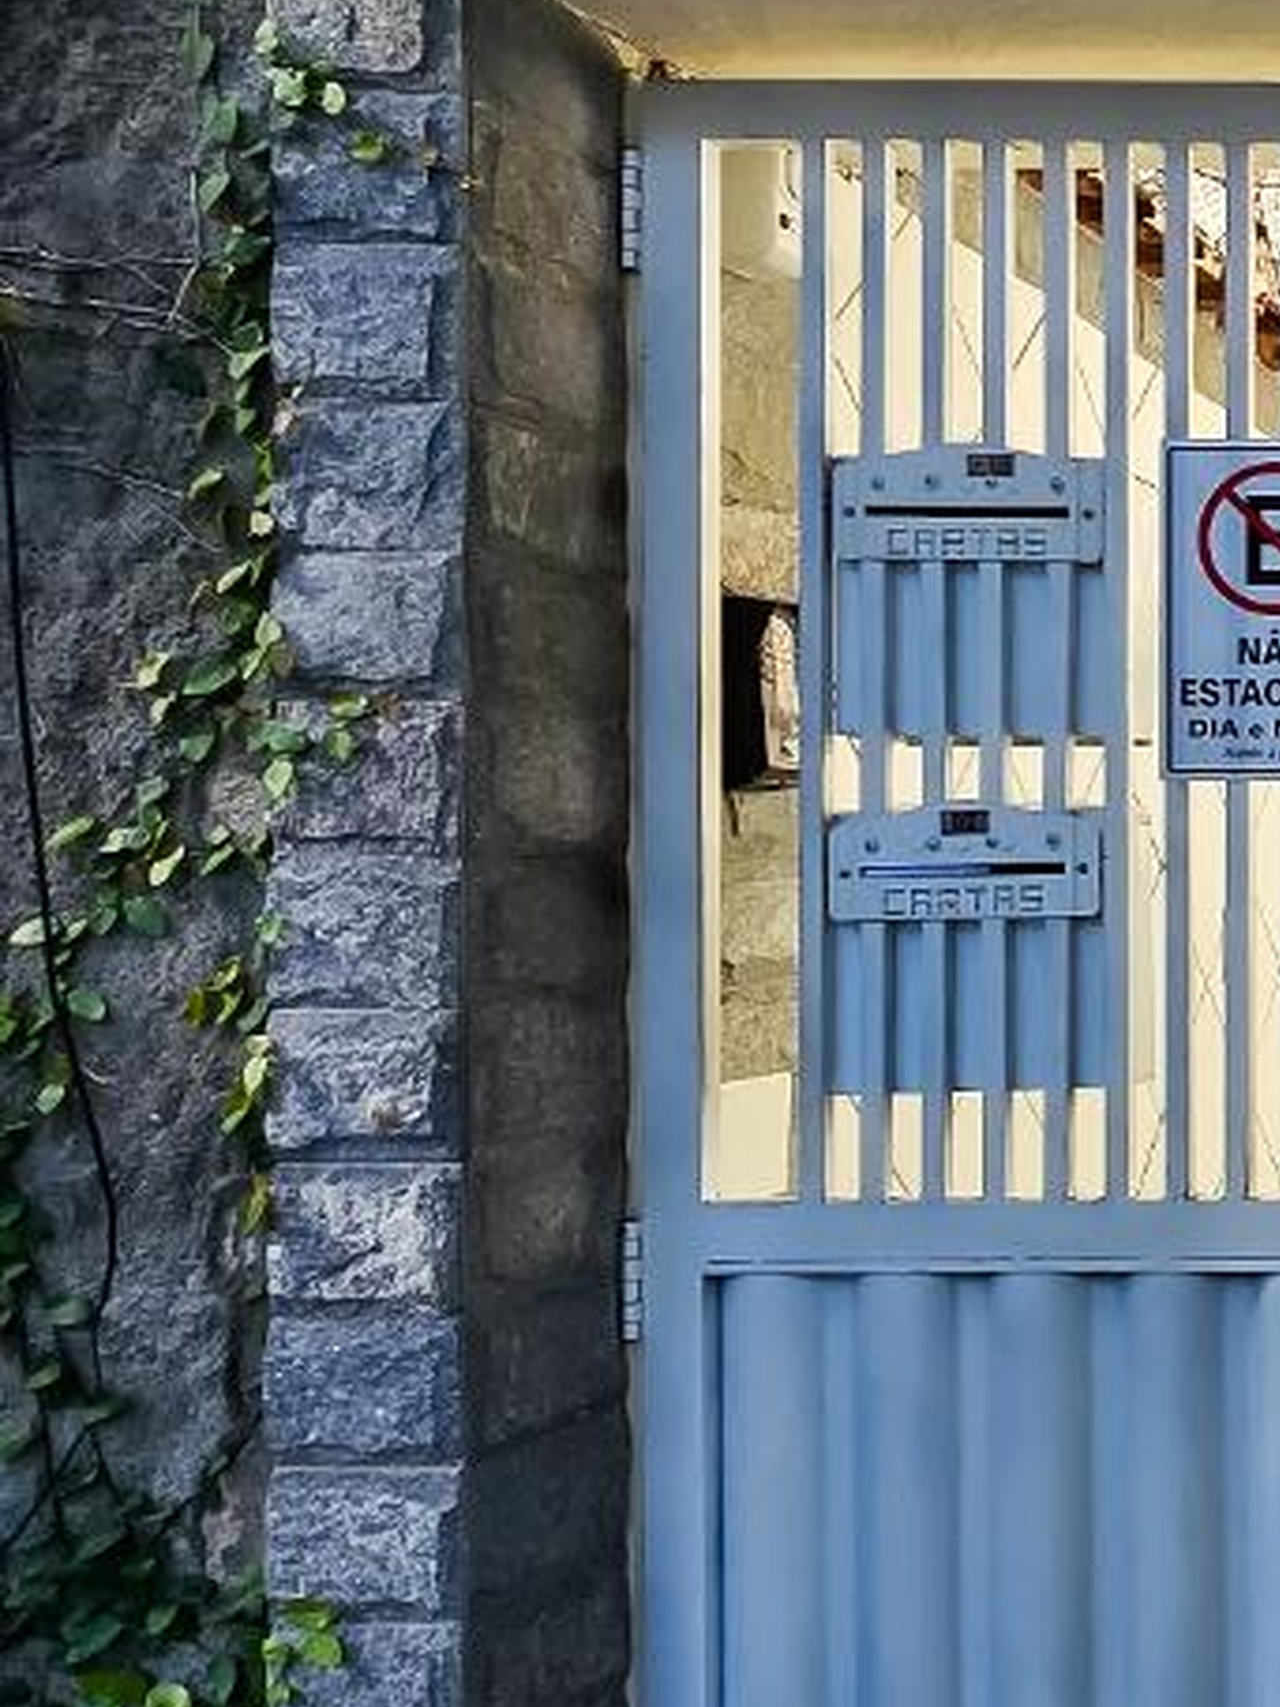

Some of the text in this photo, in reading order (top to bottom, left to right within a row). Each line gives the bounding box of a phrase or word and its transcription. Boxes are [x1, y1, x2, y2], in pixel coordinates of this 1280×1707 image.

[886, 527, 1048, 557] CARTAS
[1188, 719, 1239, 740] DIA
[883, 884, 1045, 916] CARTAS
